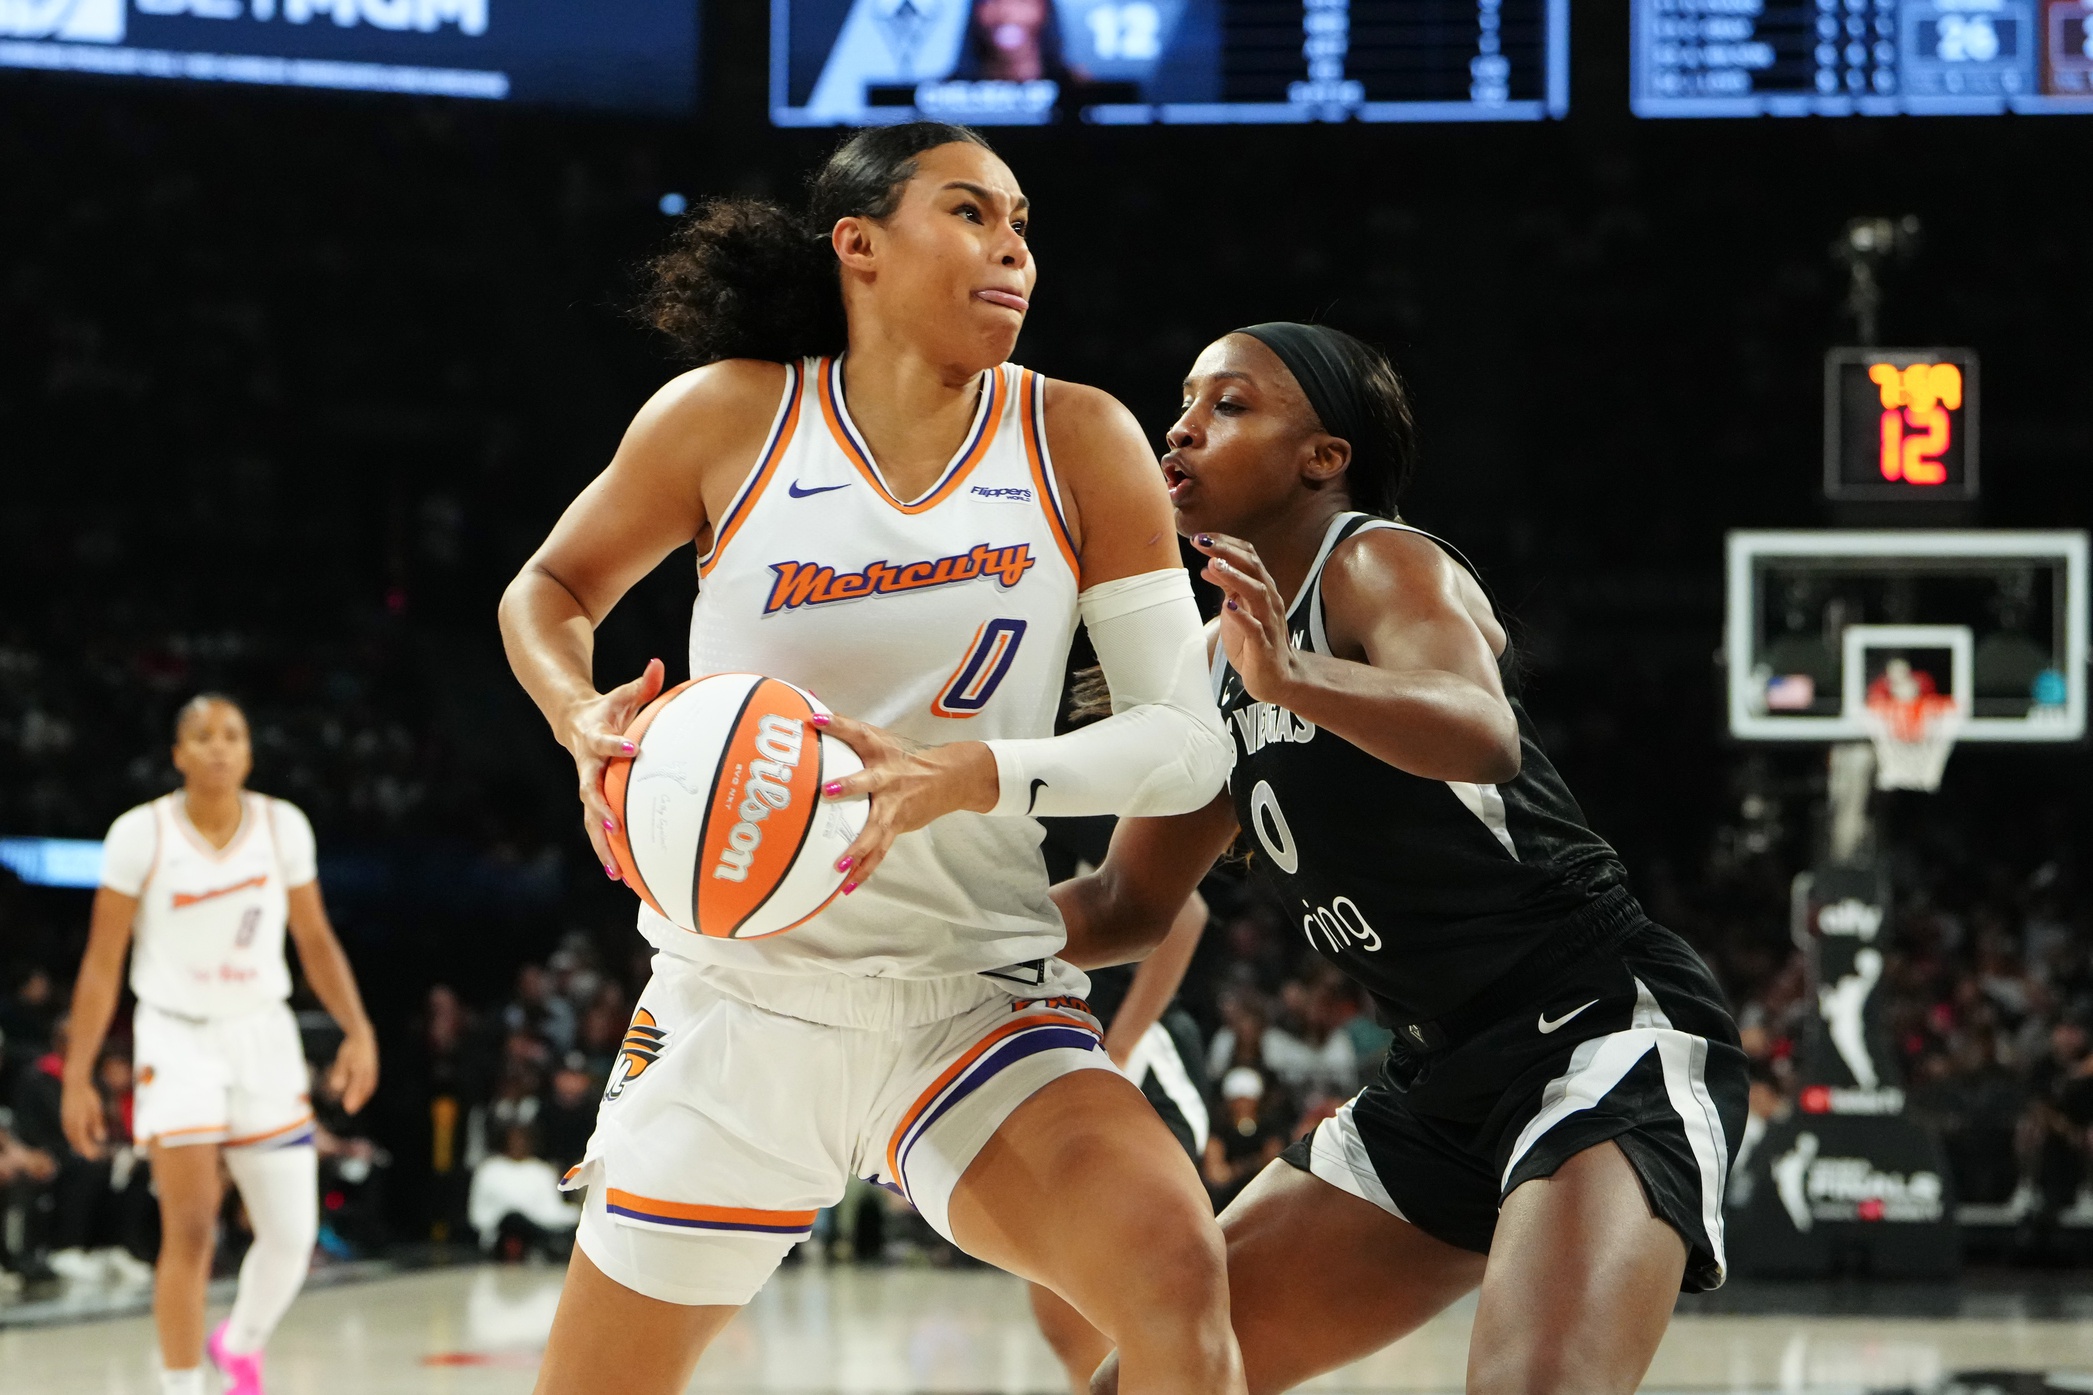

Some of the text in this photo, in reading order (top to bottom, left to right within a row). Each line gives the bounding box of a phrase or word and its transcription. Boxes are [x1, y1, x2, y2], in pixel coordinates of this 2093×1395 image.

[1880, 408, 1950, 484] 12
[762, 543, 1036, 616] Mercury
[931, 618, 1027, 718] 0
[711, 713, 805, 884] Wilson
[1251, 779, 1299, 875] 0
[1302, 895, 1382, 953] ring
